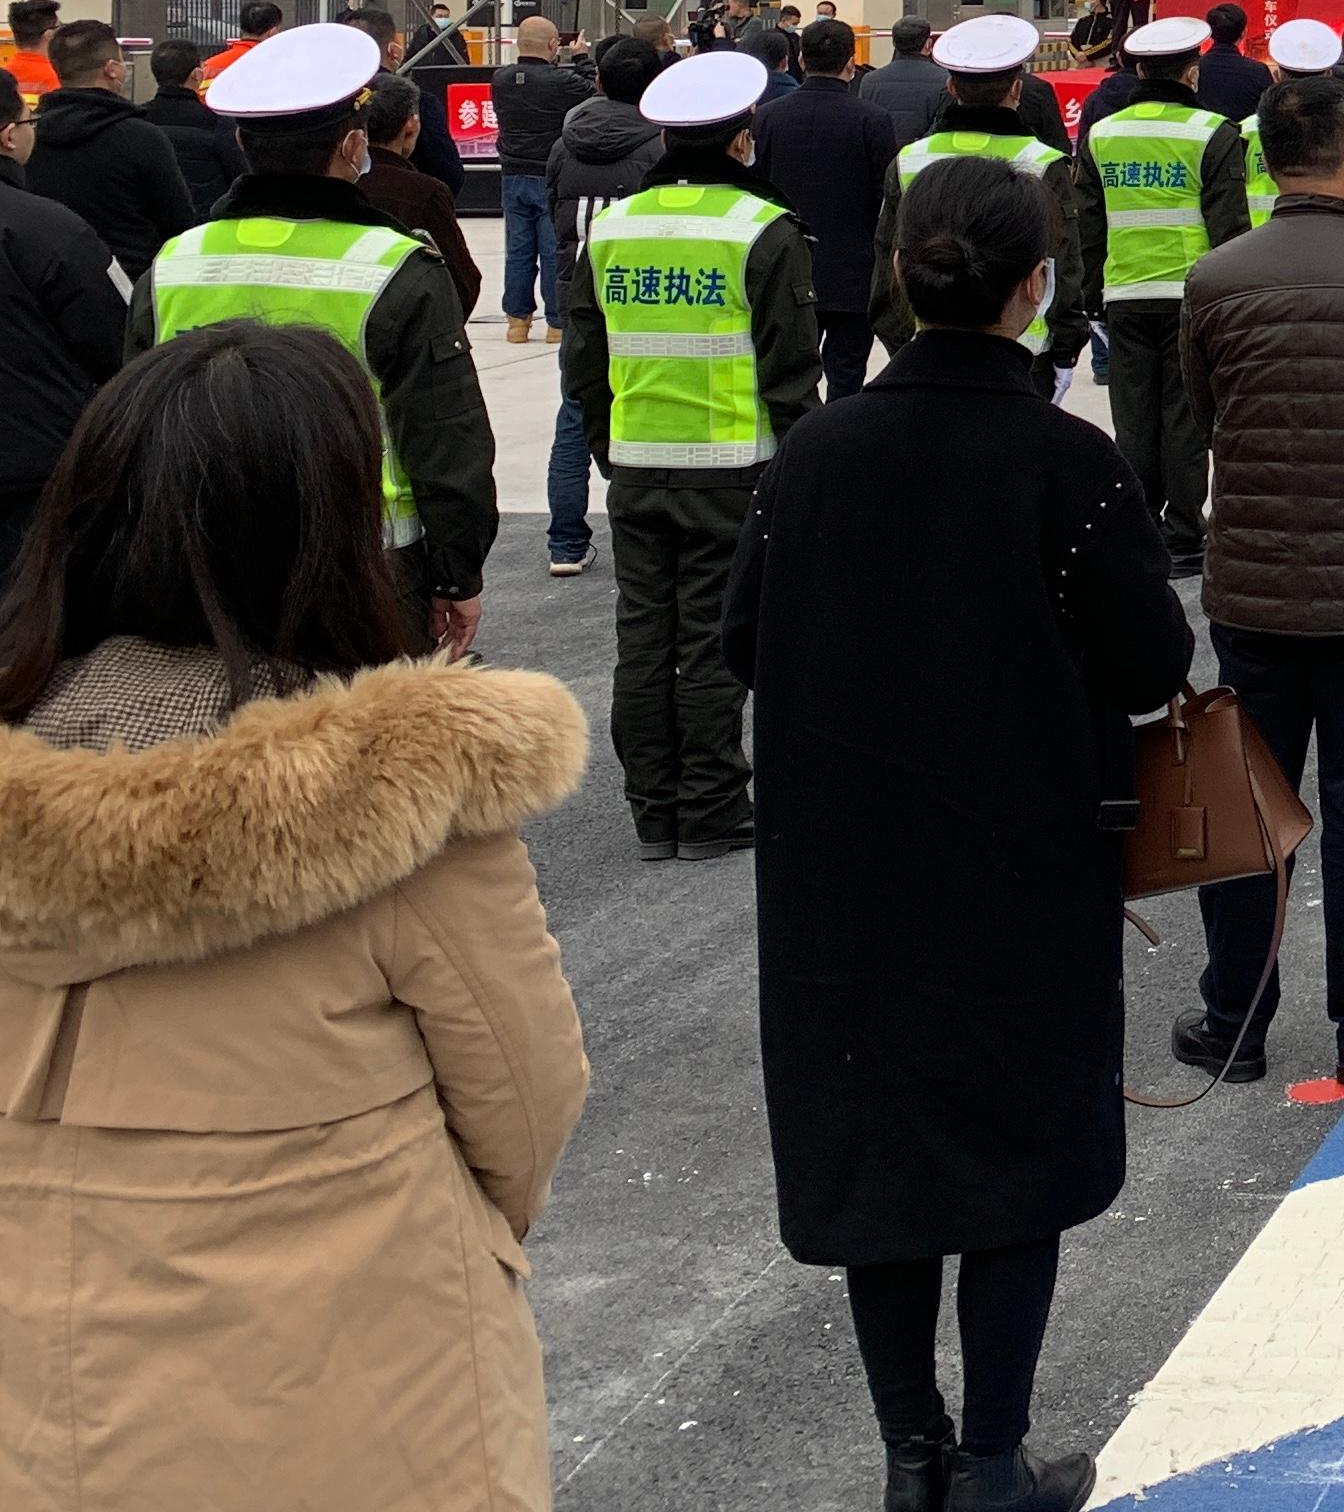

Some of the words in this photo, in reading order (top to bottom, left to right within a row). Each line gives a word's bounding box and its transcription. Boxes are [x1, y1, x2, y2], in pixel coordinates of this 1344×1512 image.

[1100, 161, 1187, 189] 高速执法
[605, 264, 727, 306] 高速执法
